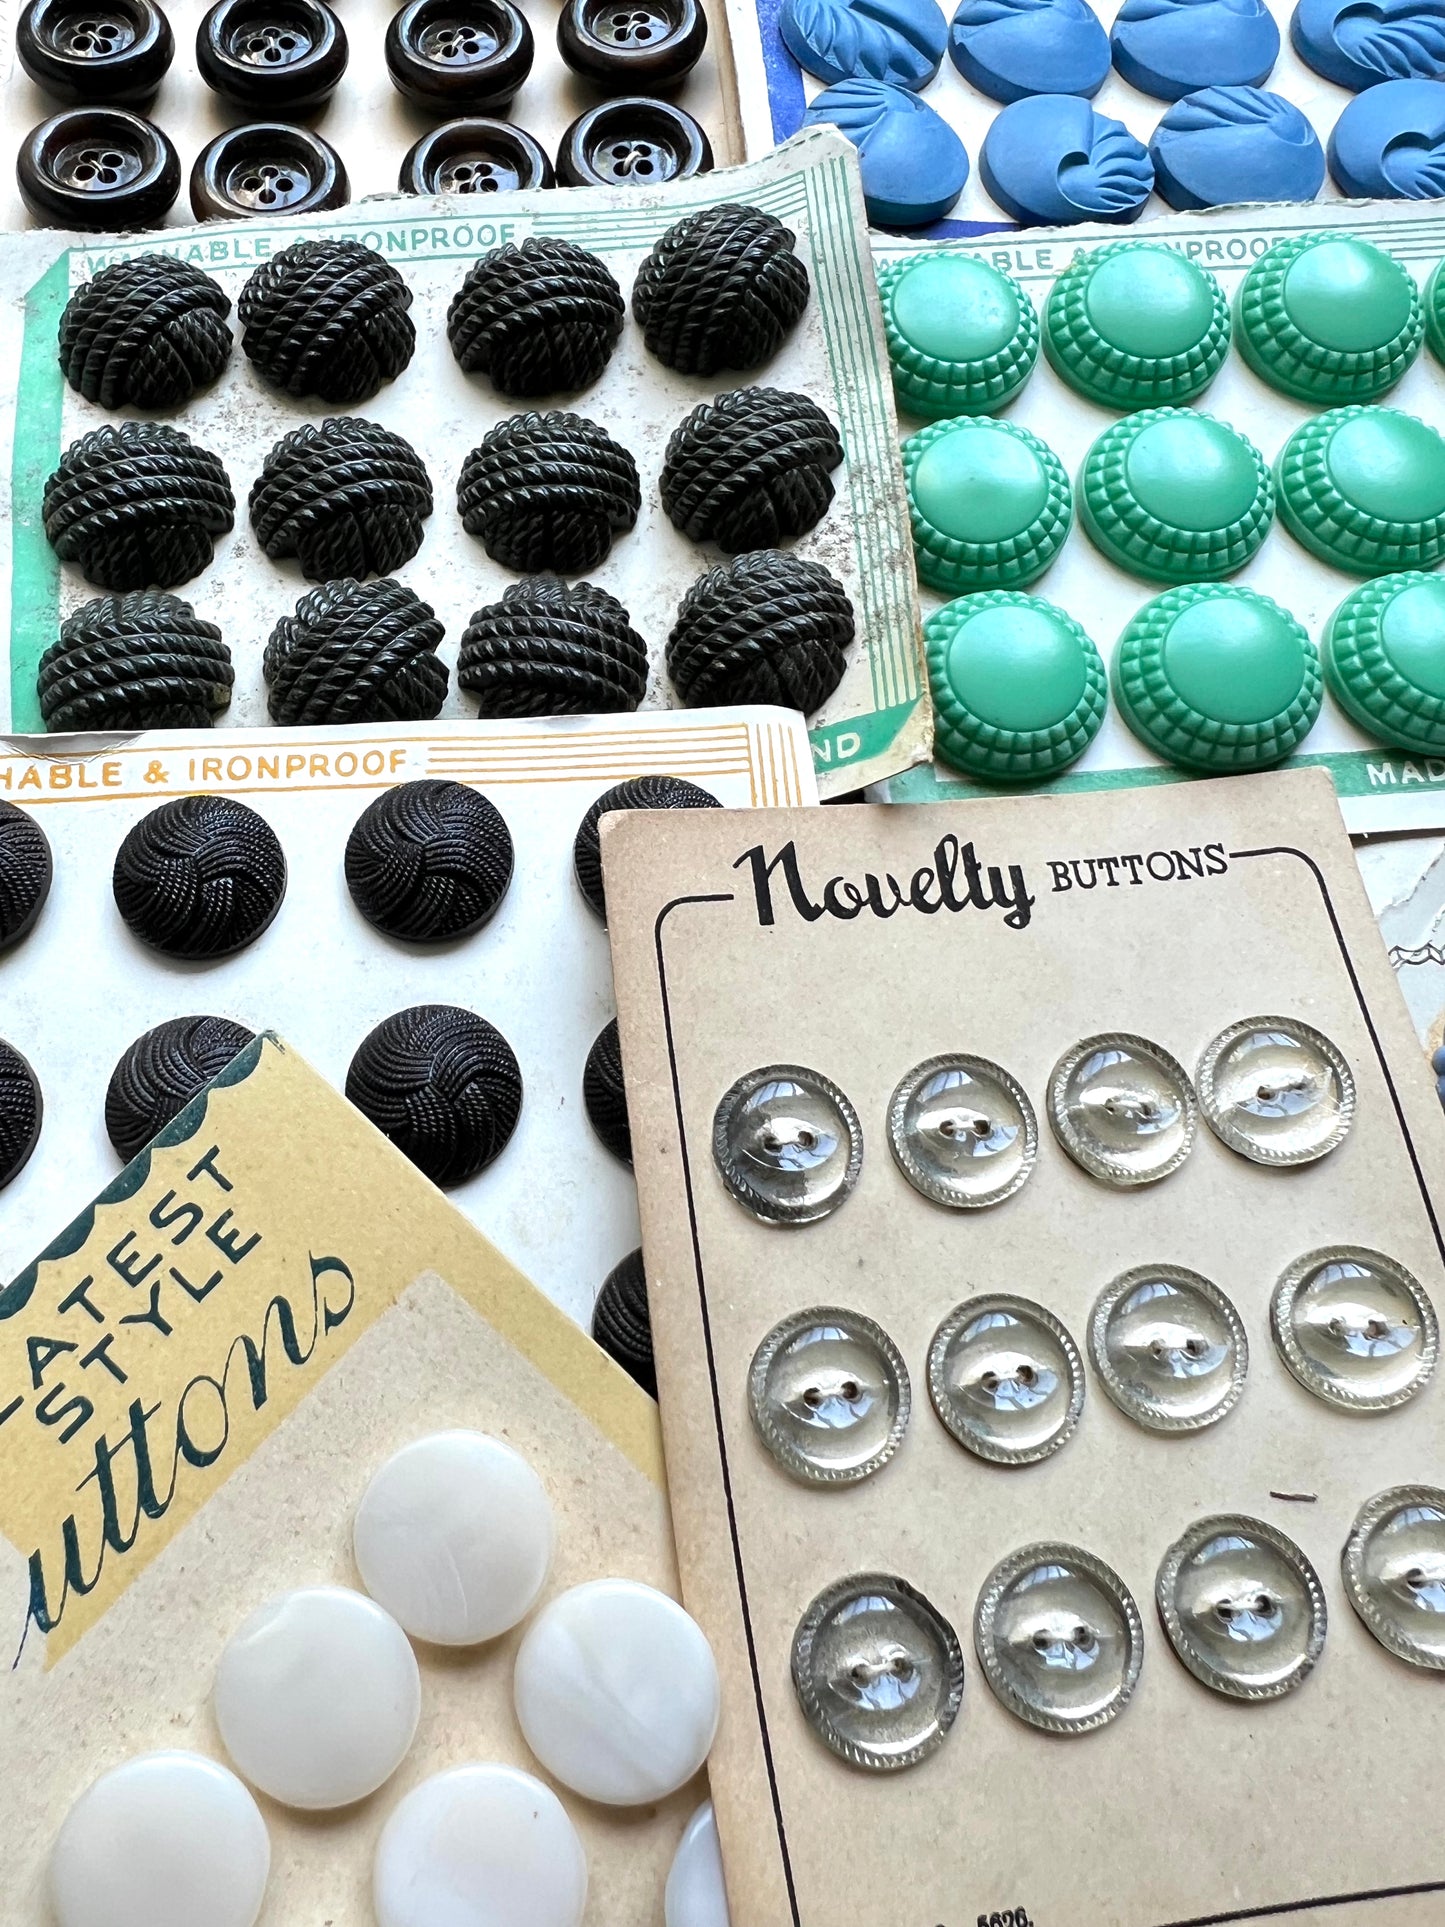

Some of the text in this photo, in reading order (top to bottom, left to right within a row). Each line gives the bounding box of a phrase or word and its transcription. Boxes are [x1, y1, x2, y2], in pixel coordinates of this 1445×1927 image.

[329, 223, 516, 252] ONPROOF
[143, 759, 171, 784] &
[189, 749, 407, 782] IRONPROOF
[732, 833, 1230, 930] Novelty BUTTONS
[35, 1207, 264, 1445] STYLE
[13, 1249, 356, 1672] uttons
